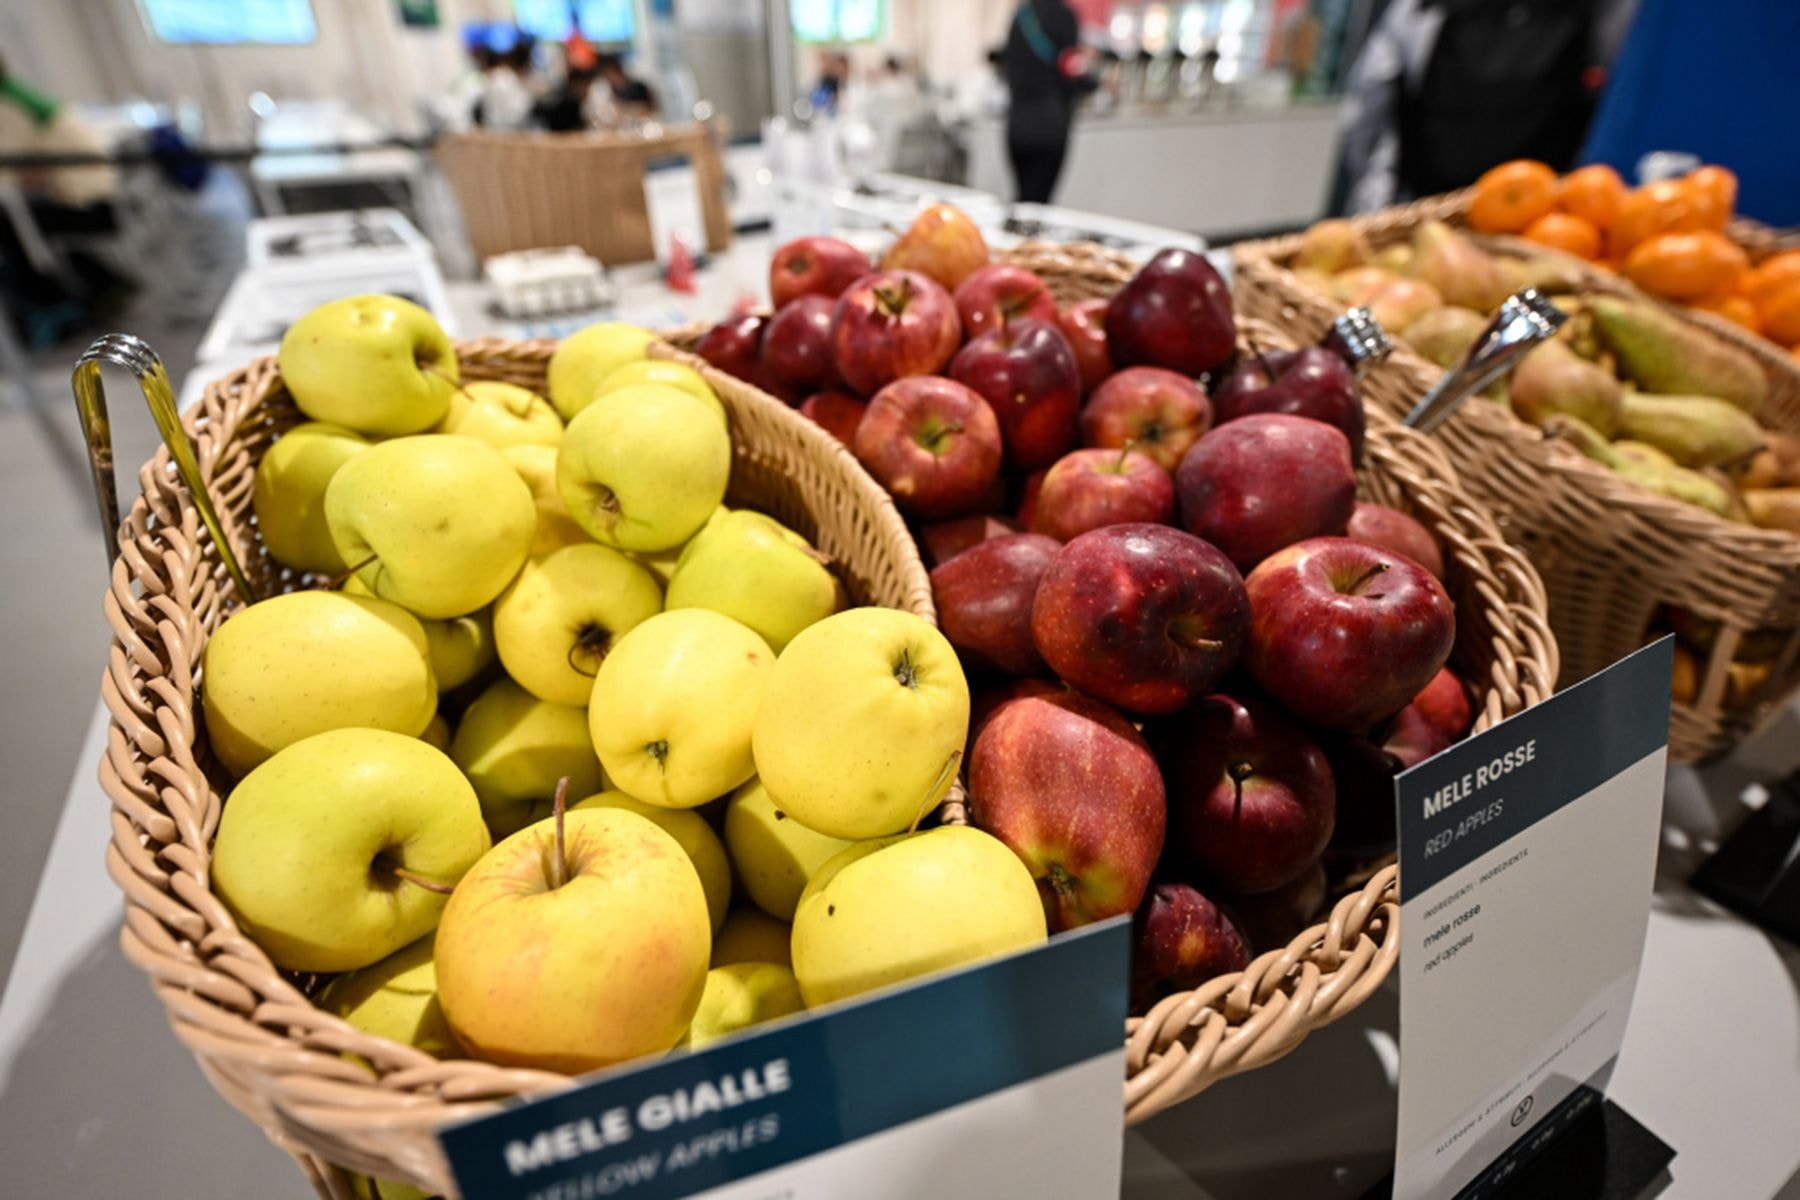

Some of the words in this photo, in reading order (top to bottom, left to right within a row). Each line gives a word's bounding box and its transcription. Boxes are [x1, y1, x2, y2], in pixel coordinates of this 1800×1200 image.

[1423, 773, 1473, 819] MELE
[1476, 739, 1536, 789] ROSSE
[1424, 828, 1453, 859] RED
[1454, 798, 1504, 841] APPLES
[1423, 923, 1451, 948] mele
[1452, 903, 1481, 929] rosse
[503, 1105, 632, 1177] MELE
[636, 1057, 792, 1132] GIALLE
[664, 1112, 780, 1172] APPLES
